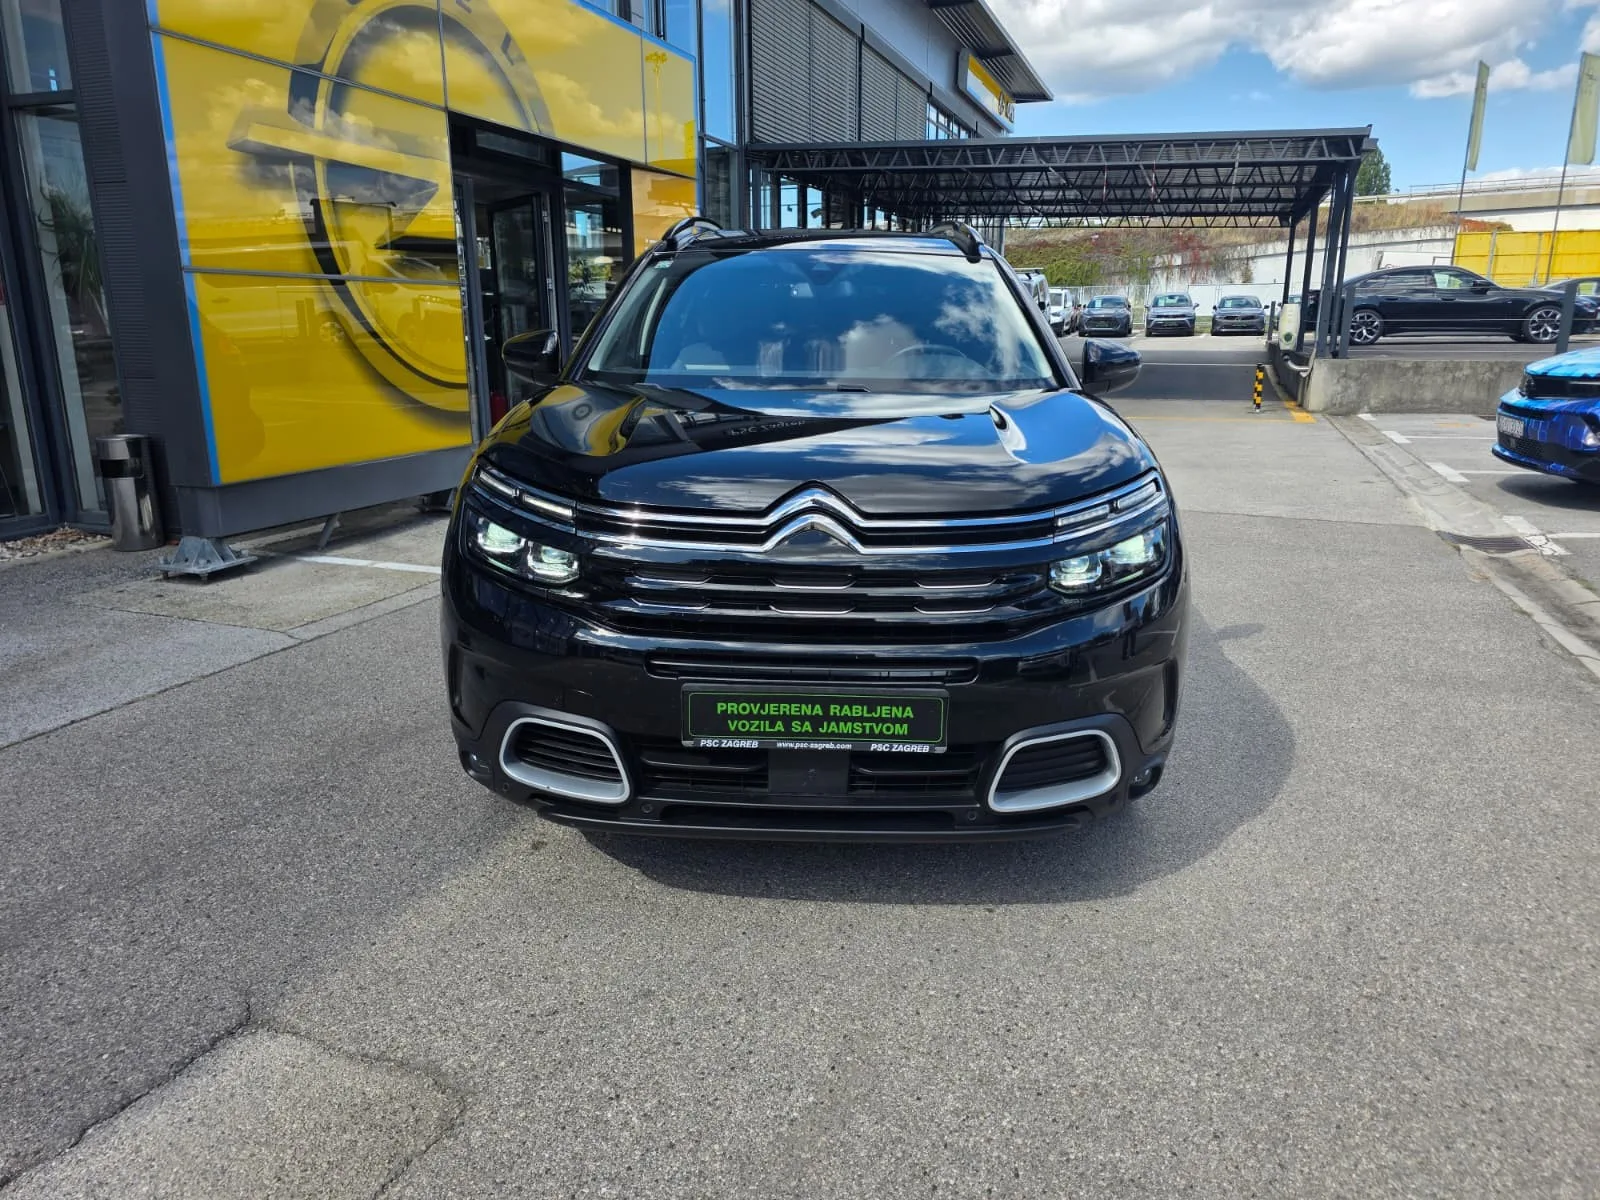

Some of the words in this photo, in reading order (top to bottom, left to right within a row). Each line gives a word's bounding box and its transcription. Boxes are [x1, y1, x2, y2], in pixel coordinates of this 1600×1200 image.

[716, 702, 824, 716] PROVJERENA
[829, 704, 914, 718] RABLJENA
[727, 720, 785, 732] VOZILA
[791, 721, 813, 732] SA
[819, 721, 909, 735] JAMSTVOM
[700, 739, 720, 748] PSC
[721, 740, 759, 748] ZAGREB
[776, 741, 852, 750] www.psc-zagreb.com
[870, 743, 890, 752] PSC
[891, 743, 930, 752] ZAGREB
